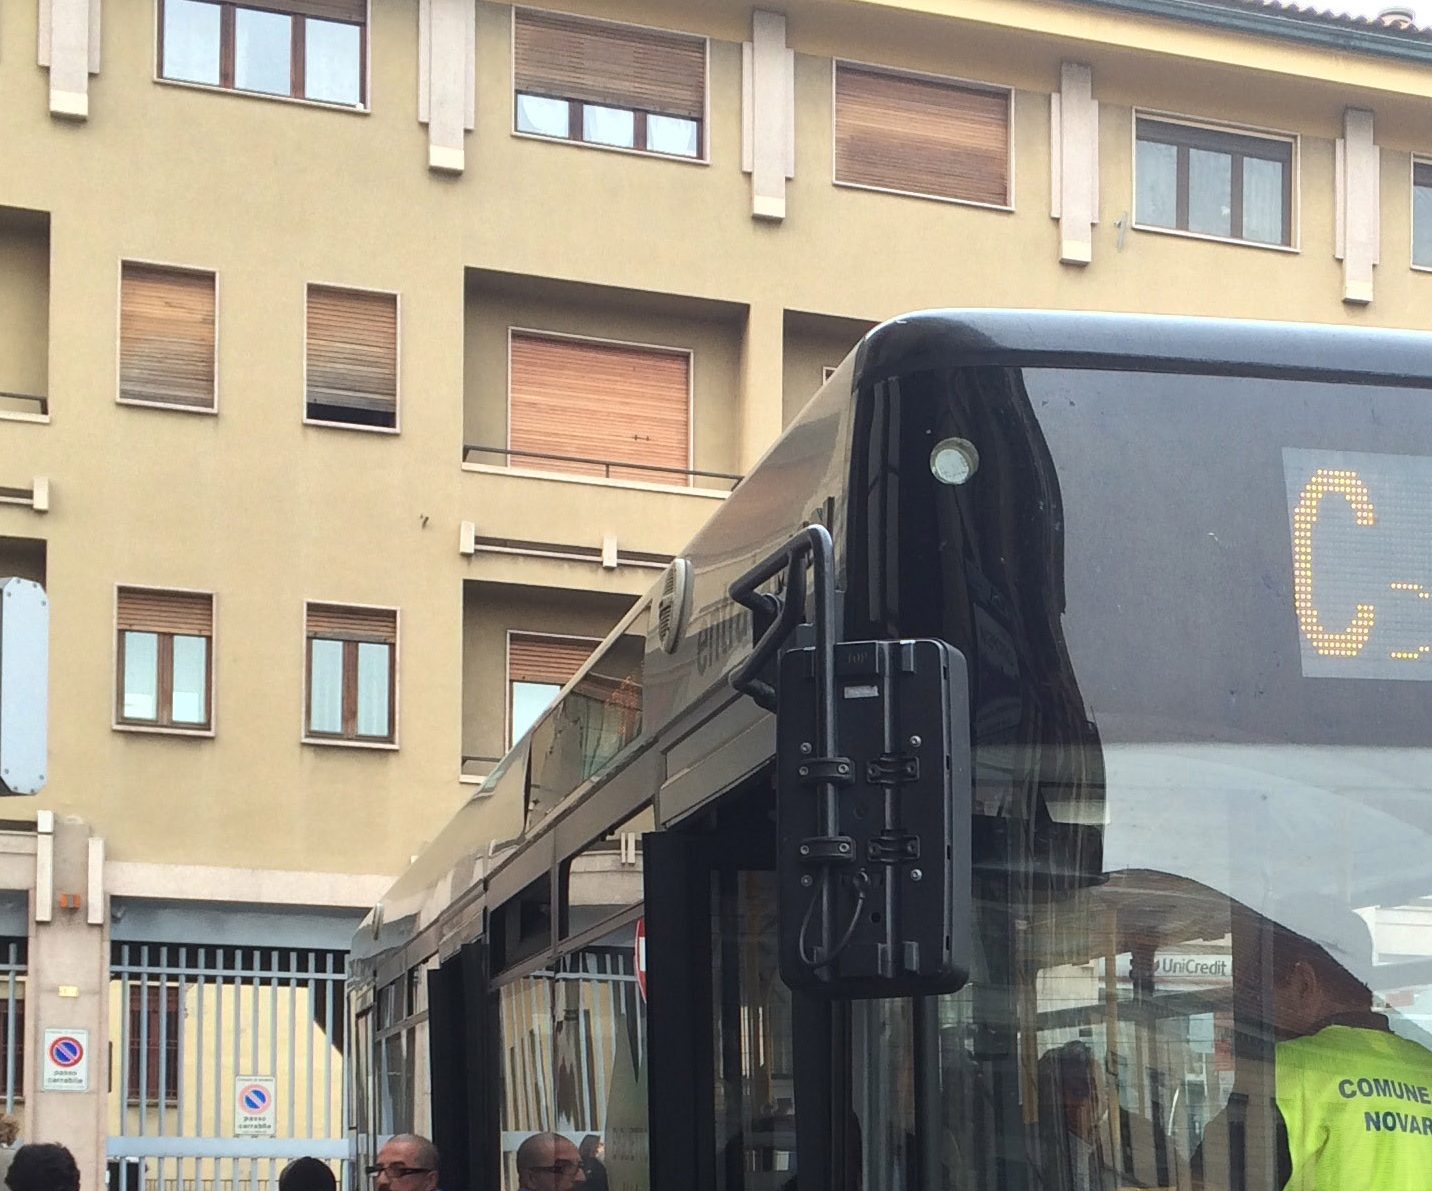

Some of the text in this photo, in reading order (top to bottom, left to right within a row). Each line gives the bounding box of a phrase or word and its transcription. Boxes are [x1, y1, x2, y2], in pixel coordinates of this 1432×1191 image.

[1293, 467, 1377, 657] C
[1162, 958, 1228, 976] UniCredit
[1338, 1077, 1432, 1105] COMUNE
